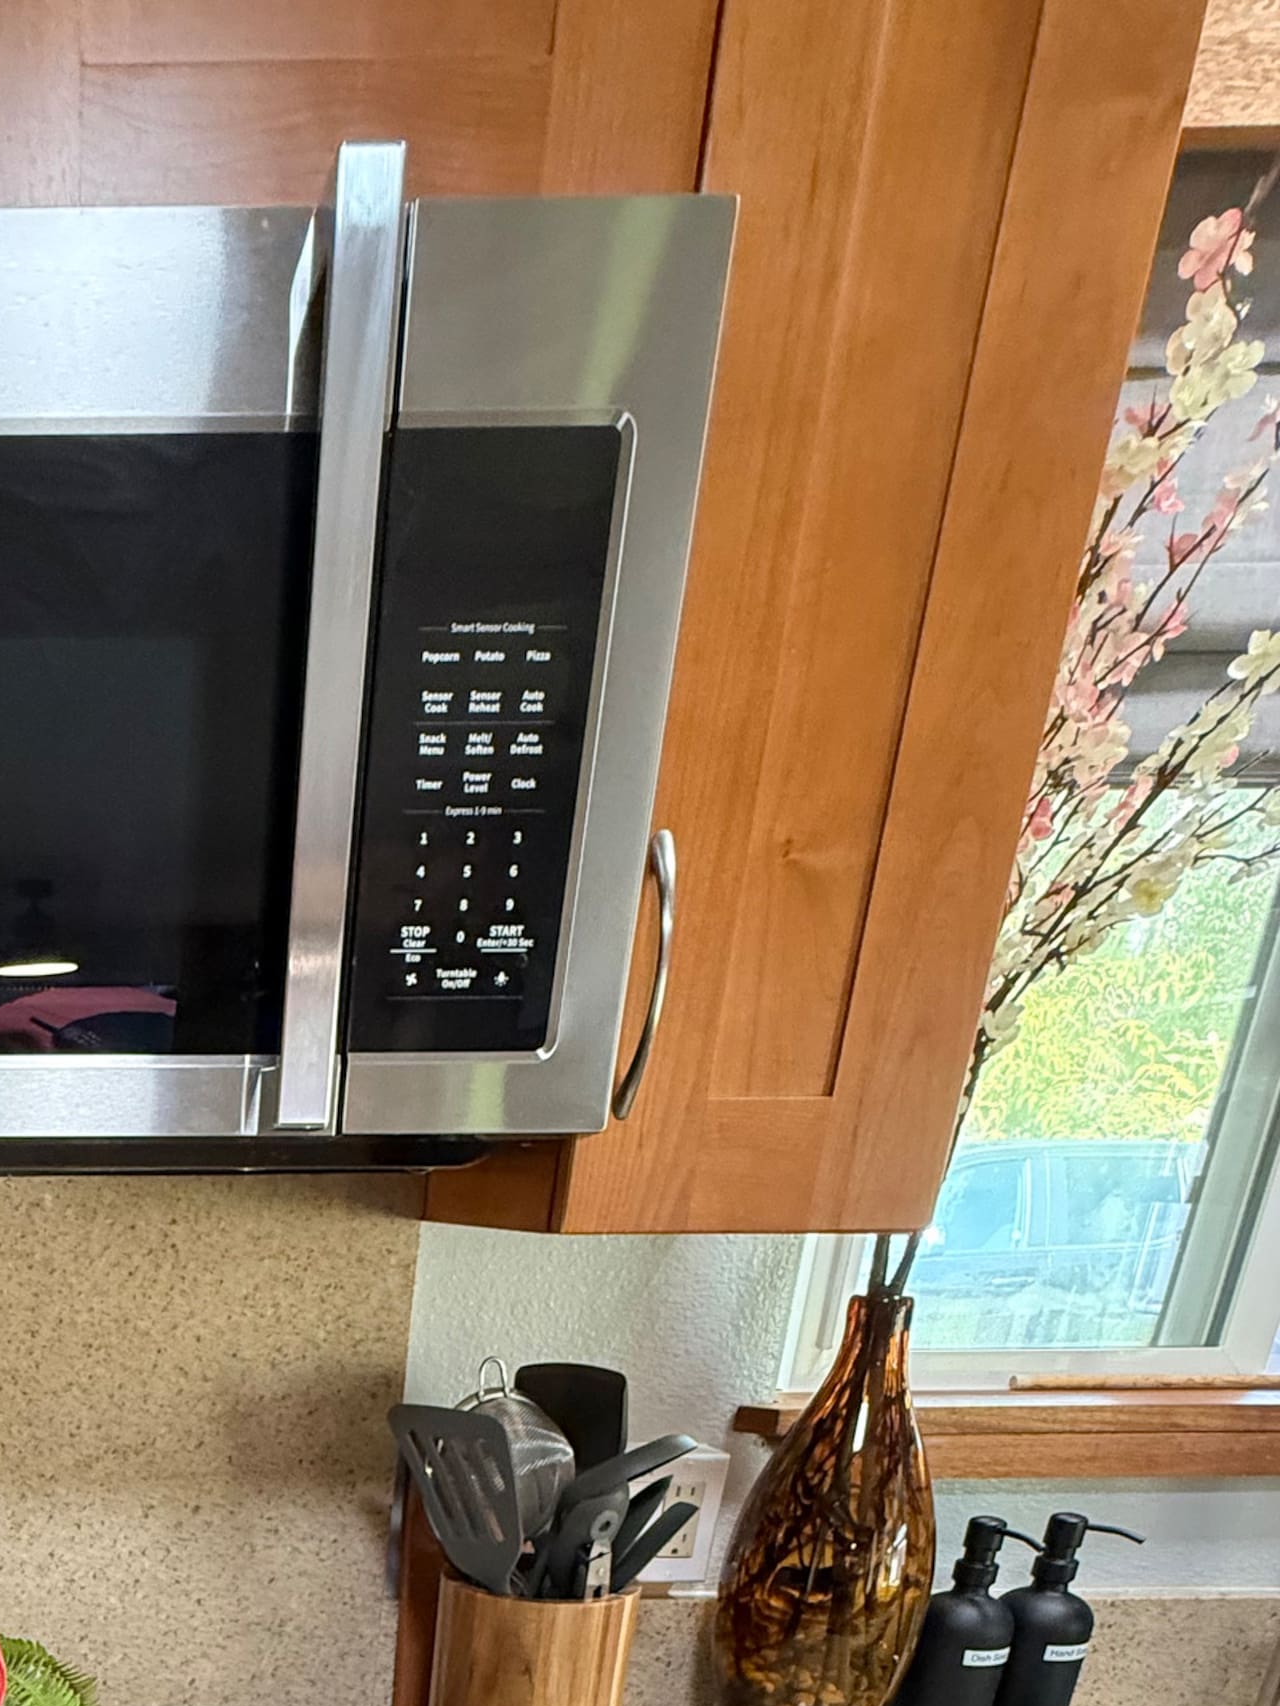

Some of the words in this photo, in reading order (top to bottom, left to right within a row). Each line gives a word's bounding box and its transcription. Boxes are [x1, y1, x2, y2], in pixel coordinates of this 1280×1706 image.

[451, 623, 475, 632] Smart
[475, 622, 502, 632] Sensor
[502, 622, 535, 634] Cooking
[422, 651, 460, 664] Popcorn
[475, 651, 505, 661] Potato
[526, 650, 551, 661] Pizza
[422, 691, 453, 701] Sensor
[470, 691, 501, 701] Sensor
[522, 690, 545, 700] Auto
[425, 703, 447, 713] Cook
[469, 702, 500, 712] Reheat
[520, 702, 543, 712] Cook
[419, 733, 446, 743] Snack
[468, 733, 492, 744] Melt/
[517, 733, 539, 743] Auto
[419, 745, 444, 755] Menu
[465, 744, 494, 755] Soften
[510, 744, 543, 754] Defrost
[463, 772, 491, 781] Power
[416, 779, 442, 789] Timer
[464, 783, 488, 793] Level
[511, 778, 536, 789] Clock
[445, 806, 473, 817] Express
[486, 807, 502, 815] min
[419, 832, 428, 845] 1
[466, 832, 476, 844] 2
[512, 831, 522, 844] 3
[415, 866, 426, 878] 4
[462, 865, 472, 877] 5
[508, 865, 519, 877] 6
[413, 899, 423, 911] 7
[459, 899, 469, 911] 8
[505, 899, 515, 911] 9
[401, 926, 430, 938] STOP
[490, 925, 524, 937] START
[455, 931, 466, 943] 0
[403, 939, 426, 948] Clear
[518, 938, 533, 949] Sec
[405, 954, 421, 962] Eco
[436, 969, 477, 978] Turntable
[441, 979, 471, 989] On/Off
